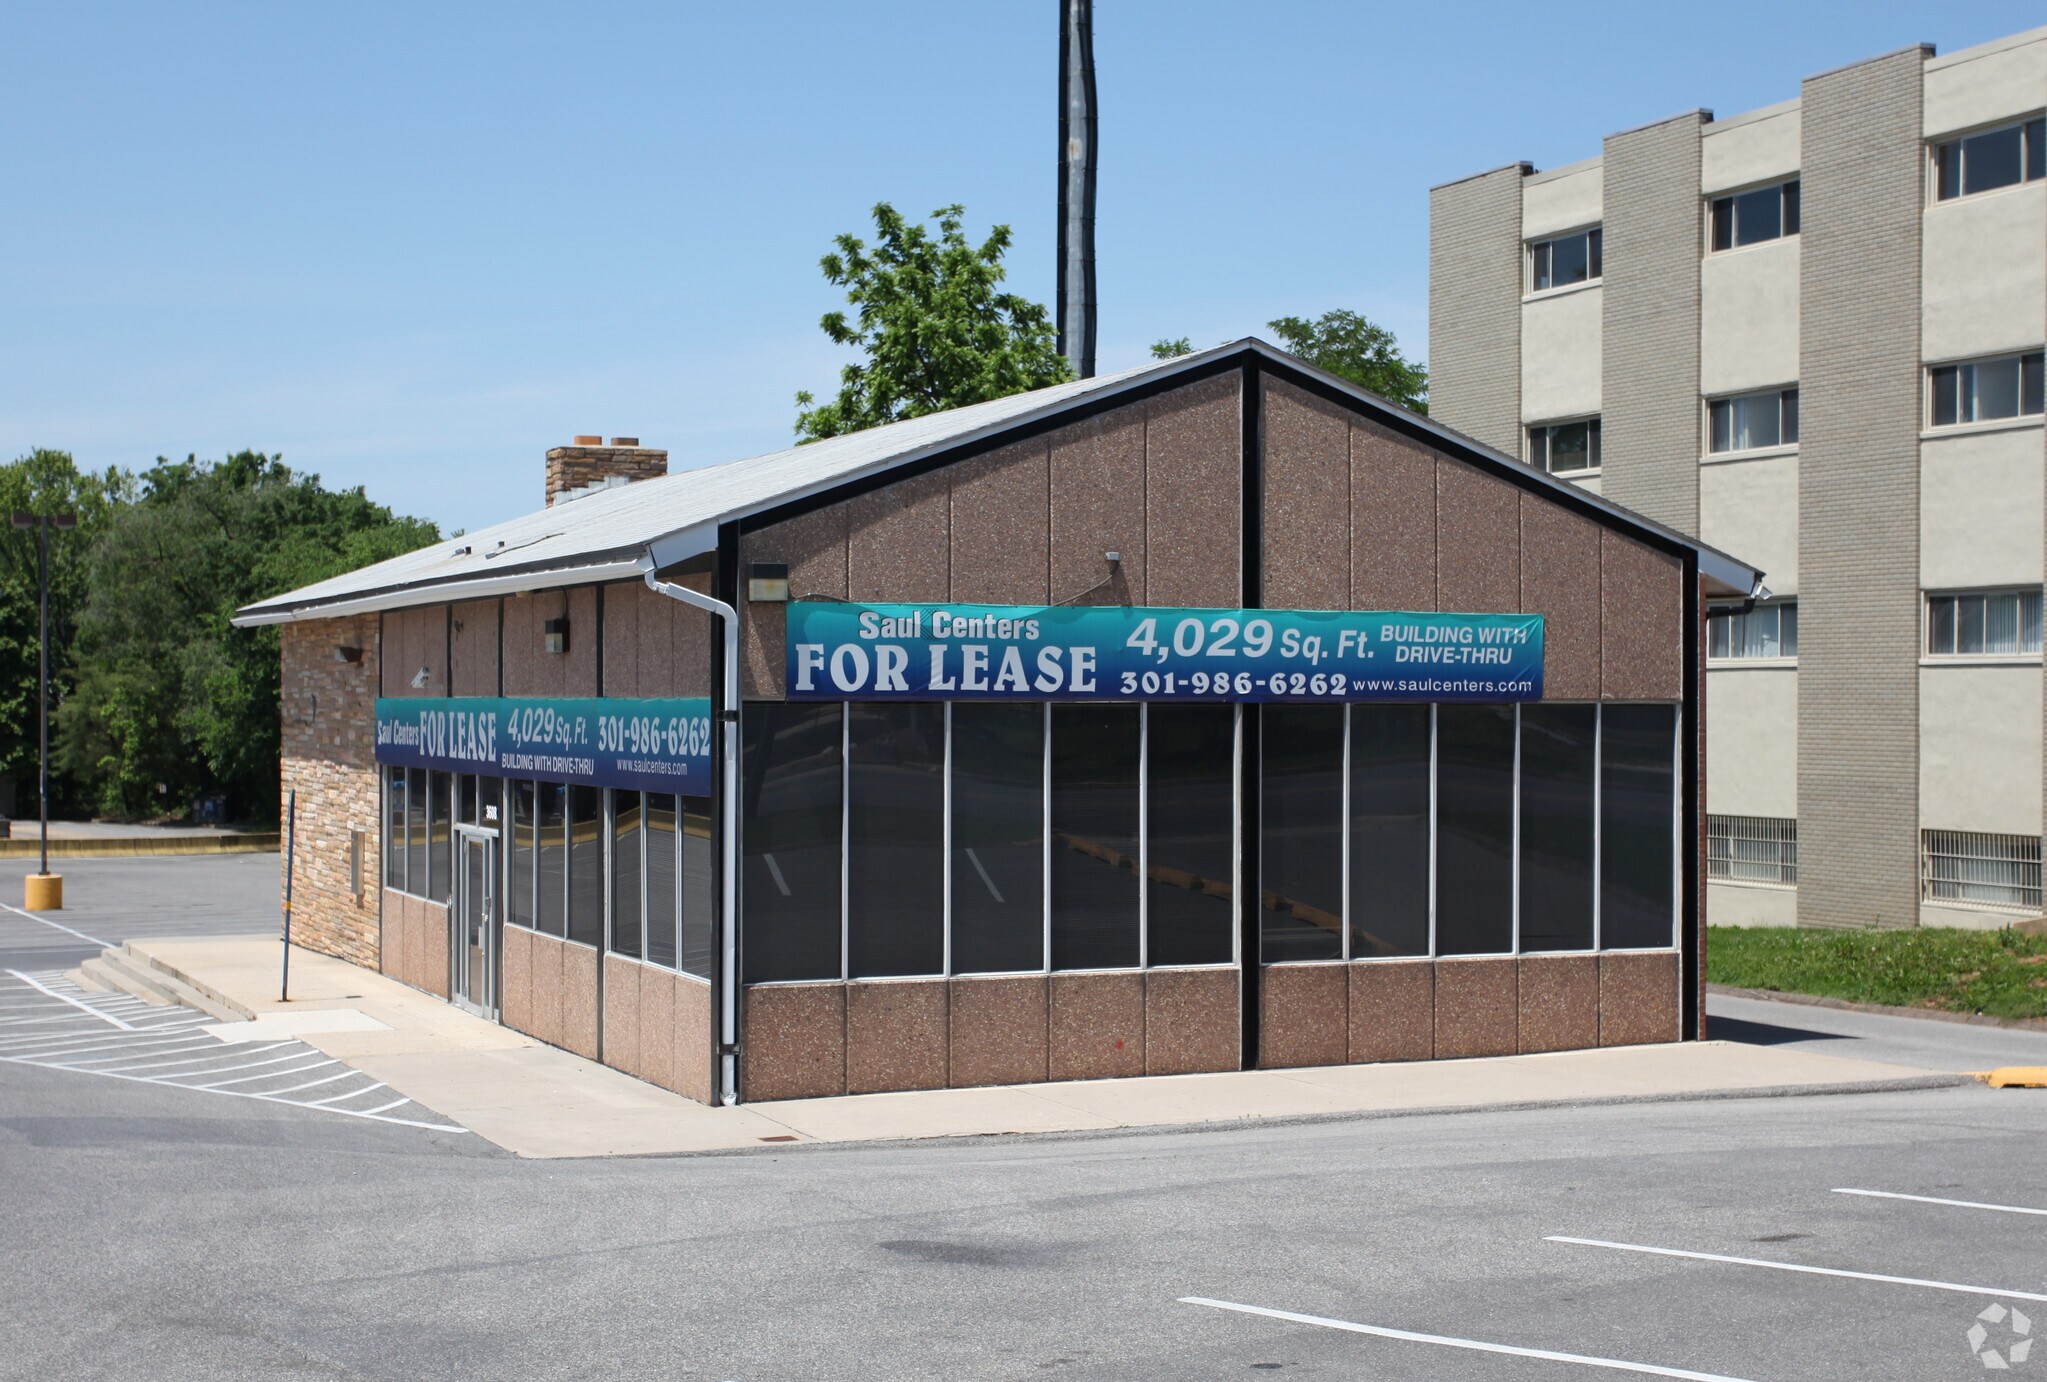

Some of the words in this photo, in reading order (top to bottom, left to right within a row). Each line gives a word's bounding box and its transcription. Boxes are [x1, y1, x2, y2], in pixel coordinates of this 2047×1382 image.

[858, 611, 921, 640] Saul
[931, 611, 1040, 640] Centers
[1380, 624, 1473, 644] BUILDING
[1478, 627, 1527, 645] WITH
[1126, 618, 1274, 665] 4,029
[1280, 628, 1328, 665] Sq.
[1337, 630, 1375, 659] Ft.
[795, 643, 909, 692] FOR
[928, 644, 1096, 693] LEASE
[1394, 646, 1512, 665] DRIVE-THRU
[1120, 672, 1347, 696] 301-986-6262
[1353, 678, 1532, 693] www.saulcenters.com
[377, 720, 392, 745] Saul
[393, 720, 419, 746] Centers
[420, 710, 445, 757] FOR
[449, 712, 496, 762] LEASE
[508, 707, 555, 749] 4,029
[556, 720, 572, 751] Sq.
[574, 717, 588, 745] Ft.
[598, 716, 710, 757] 301-986-6262
[502, 753, 533, 770] BUILDING
[534, 755, 551, 772] WITH
[552, 756, 594, 776] DRIVE-THRU
[617, 758, 688, 776] www.saulcenters.com
